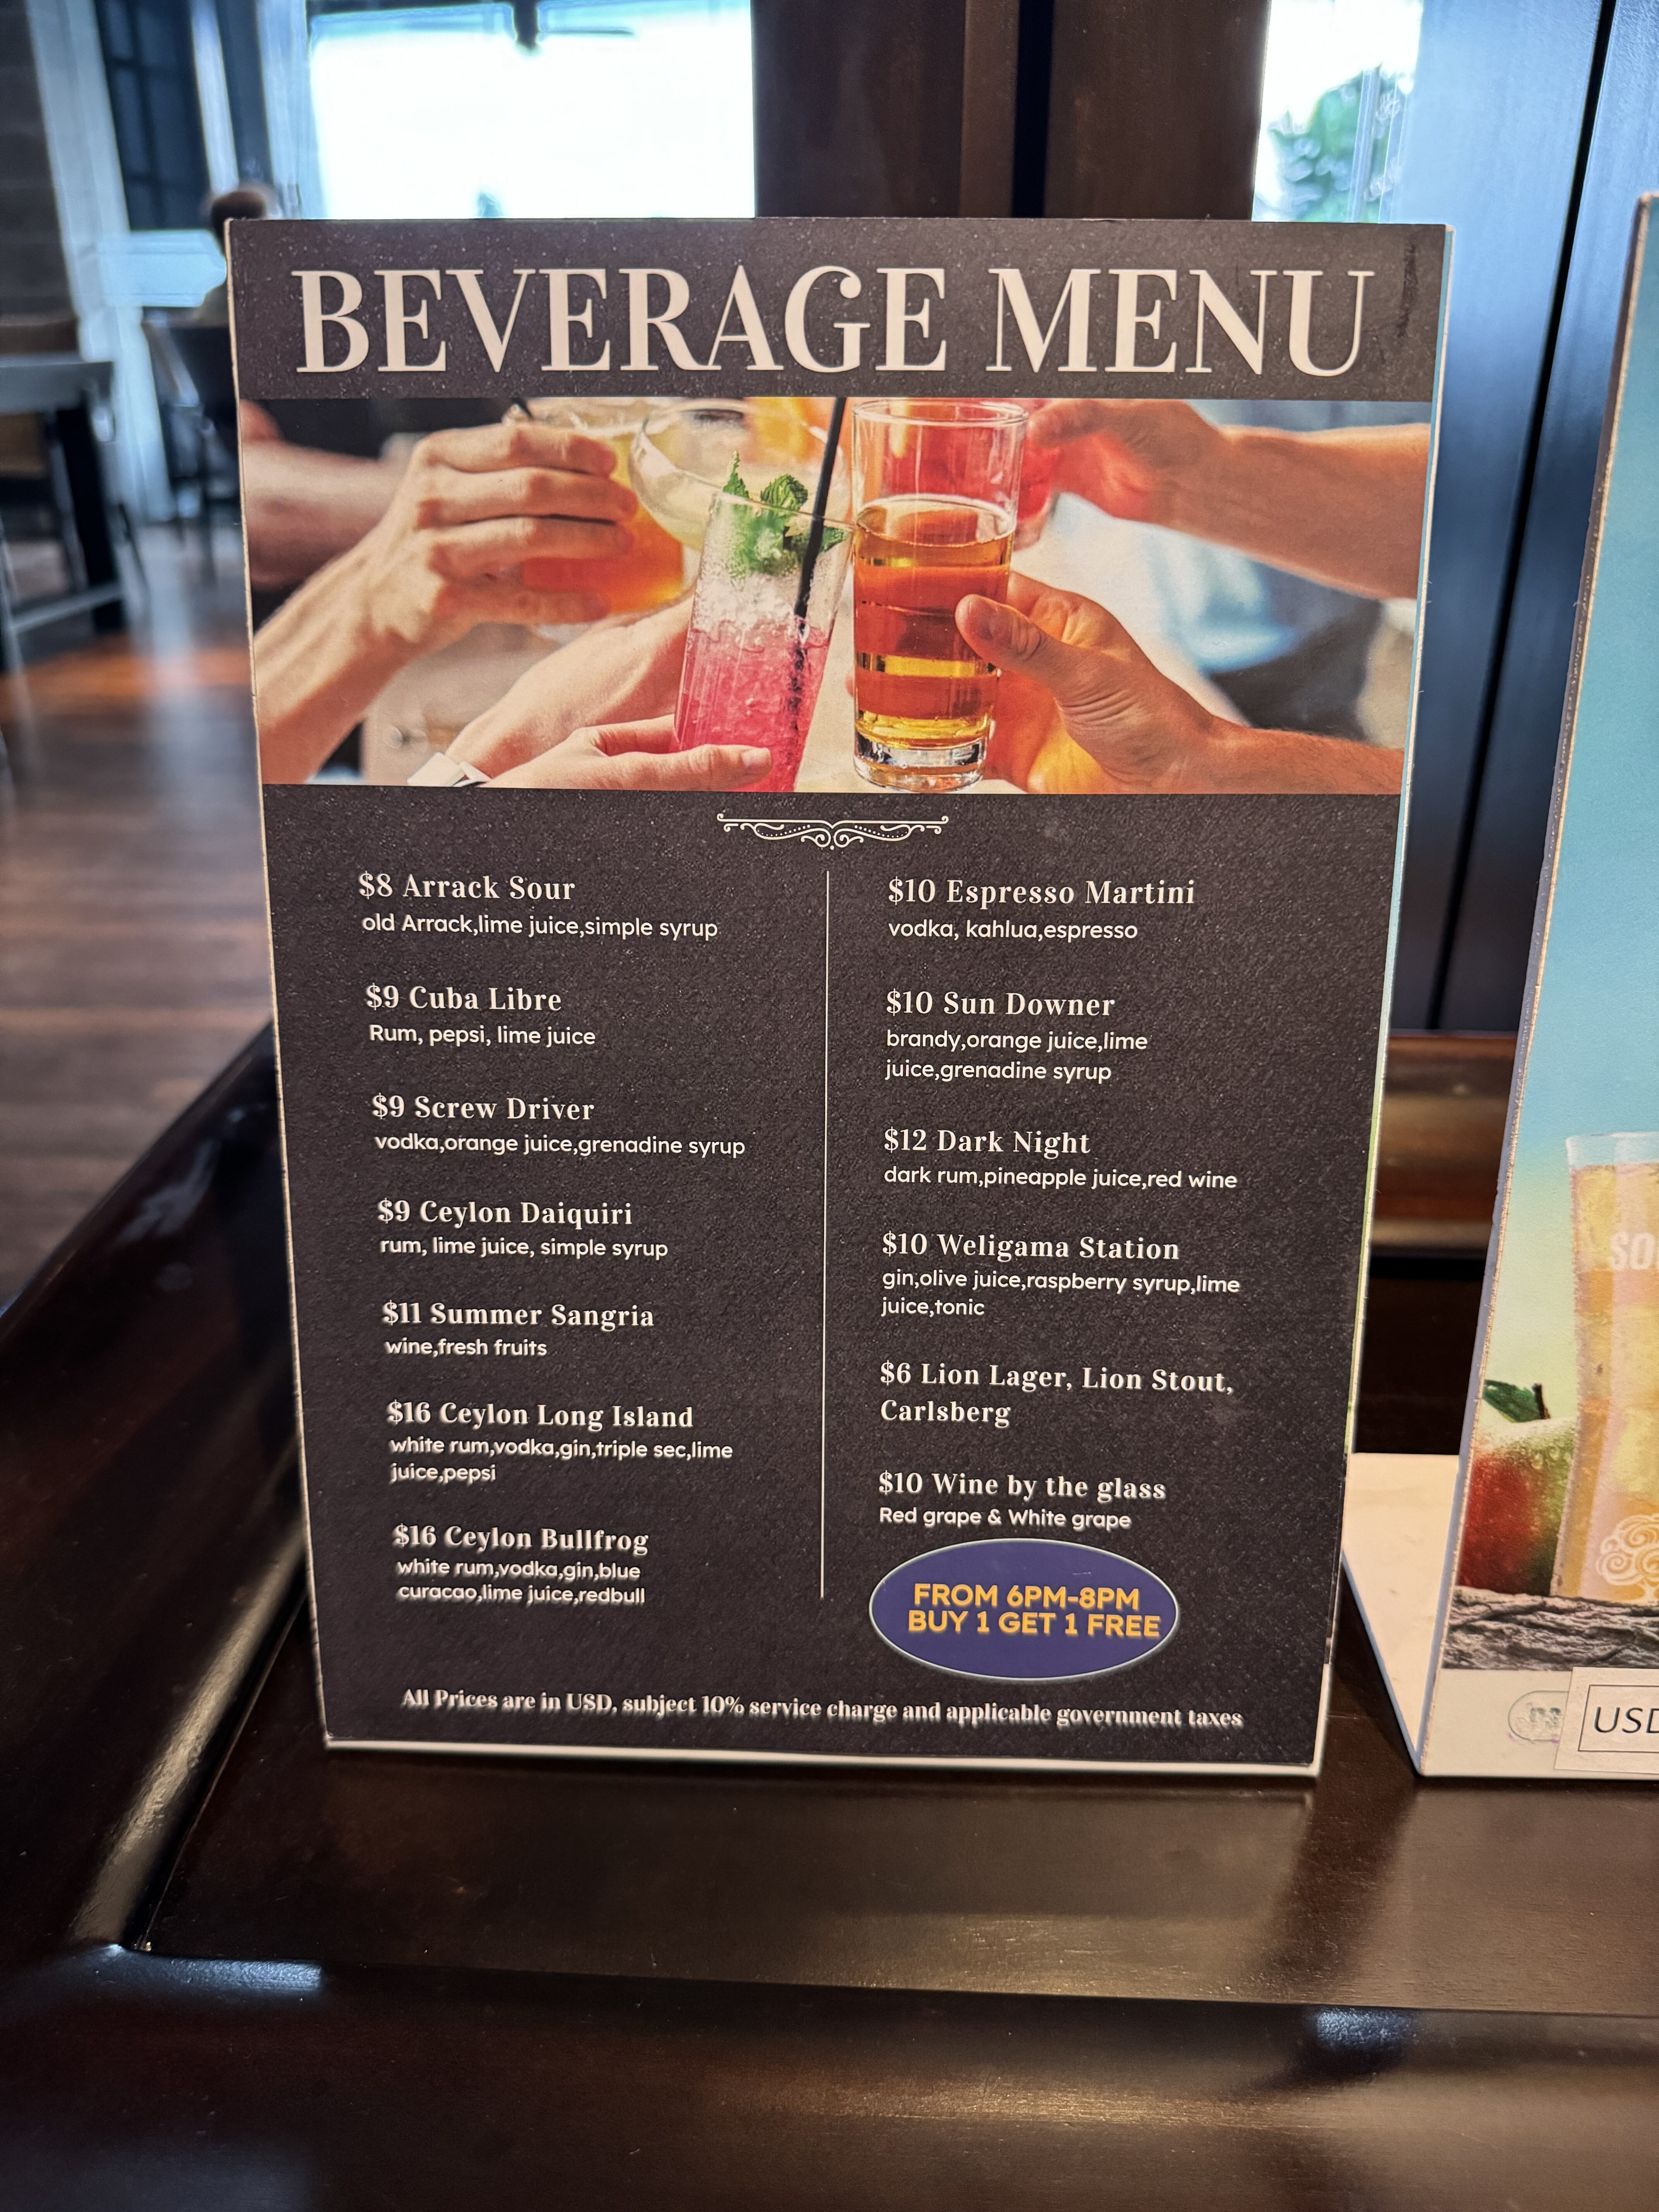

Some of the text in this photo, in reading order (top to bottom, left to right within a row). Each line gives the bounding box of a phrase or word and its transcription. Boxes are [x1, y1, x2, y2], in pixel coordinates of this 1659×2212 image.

[292, 265, 1375, 376] BEVERAGE MENU
[359, 871, 575, 900] $8 Arrack Sour
[888, 876, 1194, 910] $10 Espresso Martini
[362, 913, 718, 941] old Arrack,lime juice,simple syrup
[888, 919, 1138, 943] vodka, kahlua,espresso
[366, 983, 561, 1011] $9 Cuba Libre
[886, 988, 1115, 1016] $10 Sun Downer
[369, 1024, 596, 1048] Rum, pepsi, lime juice
[887, 1029, 1148, 1053] brandy,orange juice,lime
[884, 1060, 1111, 1084] juice,grenadine syrup
[373, 1092, 594, 1120] $9 Screw Driver
[375, 1133, 745, 1159] vodka,orange juice,grenadine syrup
[884, 1127, 1091, 1159] $12 Dark Night
[884, 1166, 1237, 1190] dark rum,pineapple juice,red wine
[378, 1198, 632, 1230] $9 Ceylon Daiquiri
[381, 1237, 668, 1261] rum, lime juice, simple syrup
[883, 1230, 1179, 1262] $10 Weligama Station
[1607, 1231, 1659, 1271] SO
[883, 1269, 1240, 1295] gin,olive juice,raspberry syrup,lime
[383, 1300, 654, 1332] $11 Summer Sangria
[881, 1298, 985, 1317] juice,tonic
[385, 1337, 547, 1357] wine,fresh fruits
[880, 1360, 1233, 1395] $6 Lion Lager, Lion Stout,
[388, 1400, 693, 1432] $16 Ceylon Long Island
[881, 1400, 1011, 1429] Carlsberg
[390, 1436, 733, 1461] white rum,vodka,gin,triple sec,lime
[391, 1463, 496, 1484] juice,pepsi
[879, 1470, 1166, 1504] $10 Wine by the glass
[880, 1507, 1132, 1532] Red grape & White grape
[394, 1523, 649, 1556] $16 Ceylon Bullfrog
[397, 1558, 641, 1582] white rum,vodka,gin,blue
[397, 1584, 645, 1605] curacao,lime juice,redbull
[914, 1583, 1139, 1611] FROM 6PM-8PM
[908, 1610, 1161, 1638] BUY 1 GET 1 FREE
[402, 1689, 1243, 1728] All Prices are in USD, subject 10% service charge and applicable government taxes
